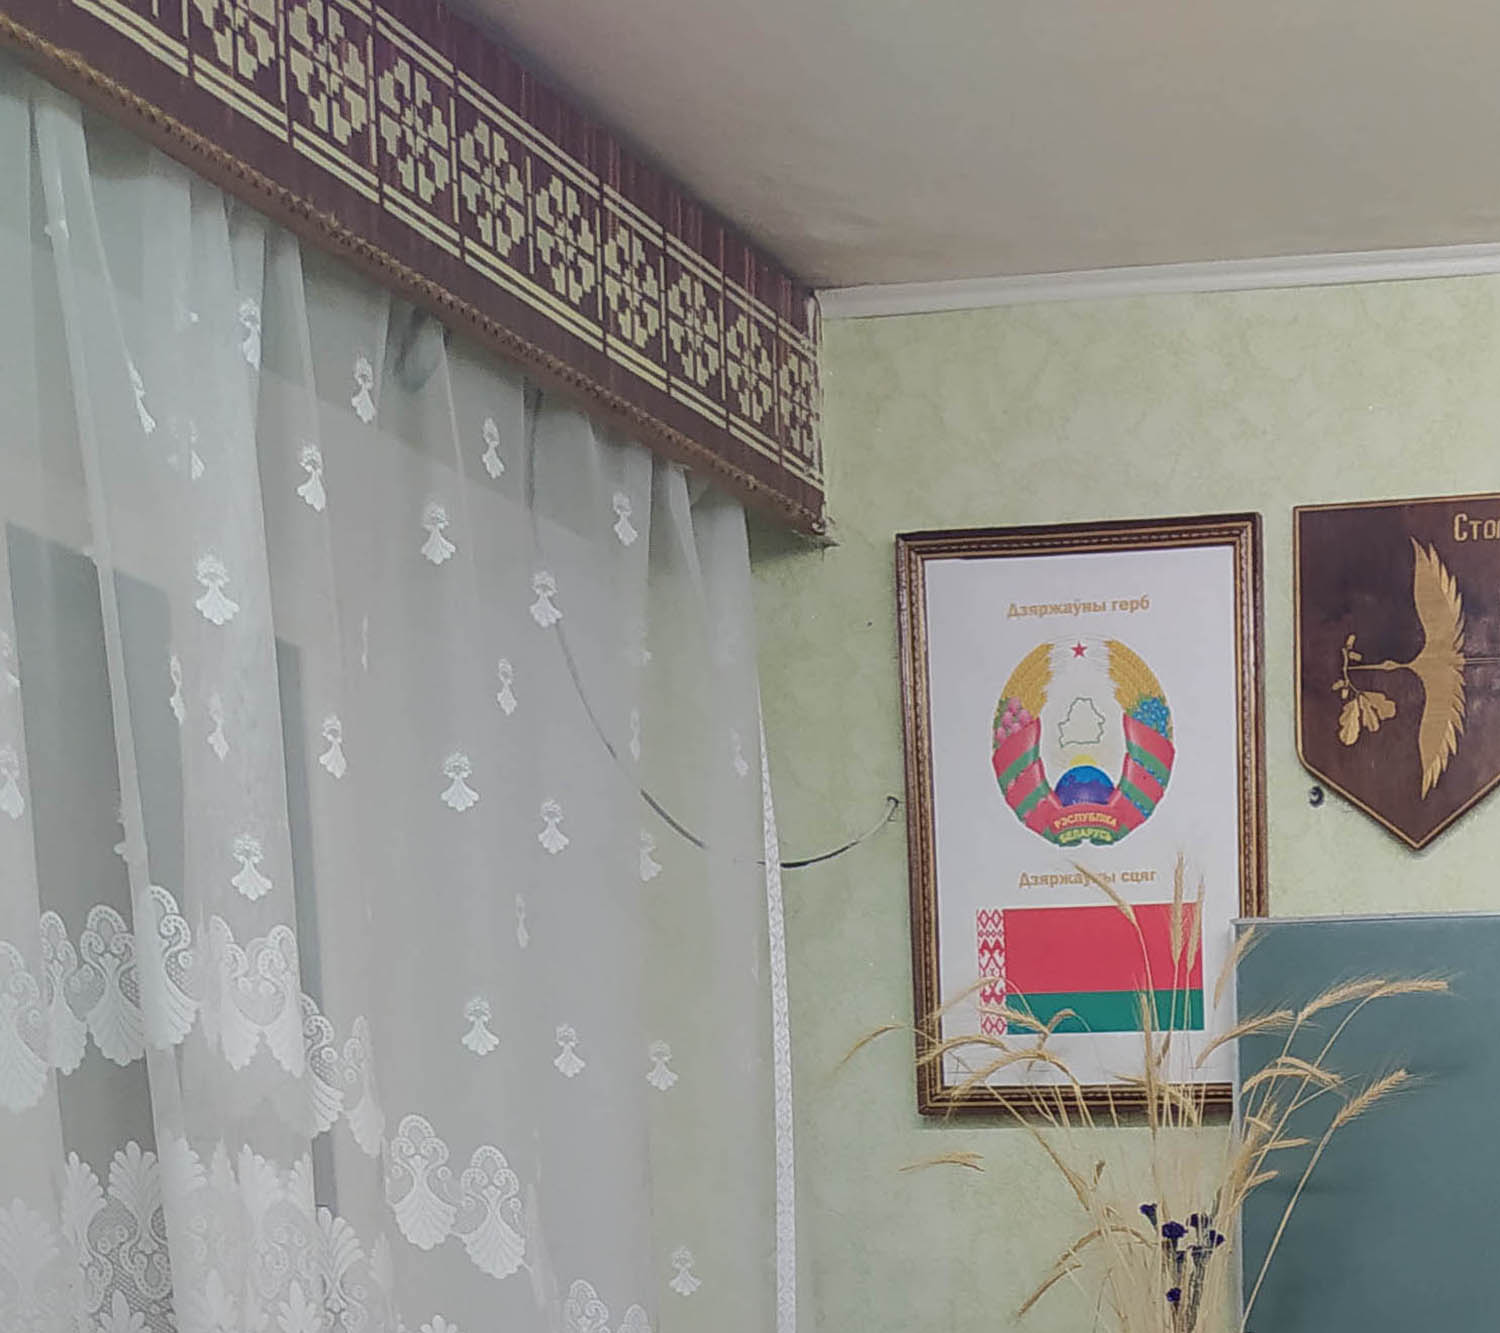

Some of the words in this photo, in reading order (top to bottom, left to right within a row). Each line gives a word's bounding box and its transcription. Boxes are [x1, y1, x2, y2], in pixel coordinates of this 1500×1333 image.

[1007, 598, 1106, 618] Дзяржаўны
[1111, 595, 1150, 613] герб
[1121, 870, 1157, 884] сцяг
